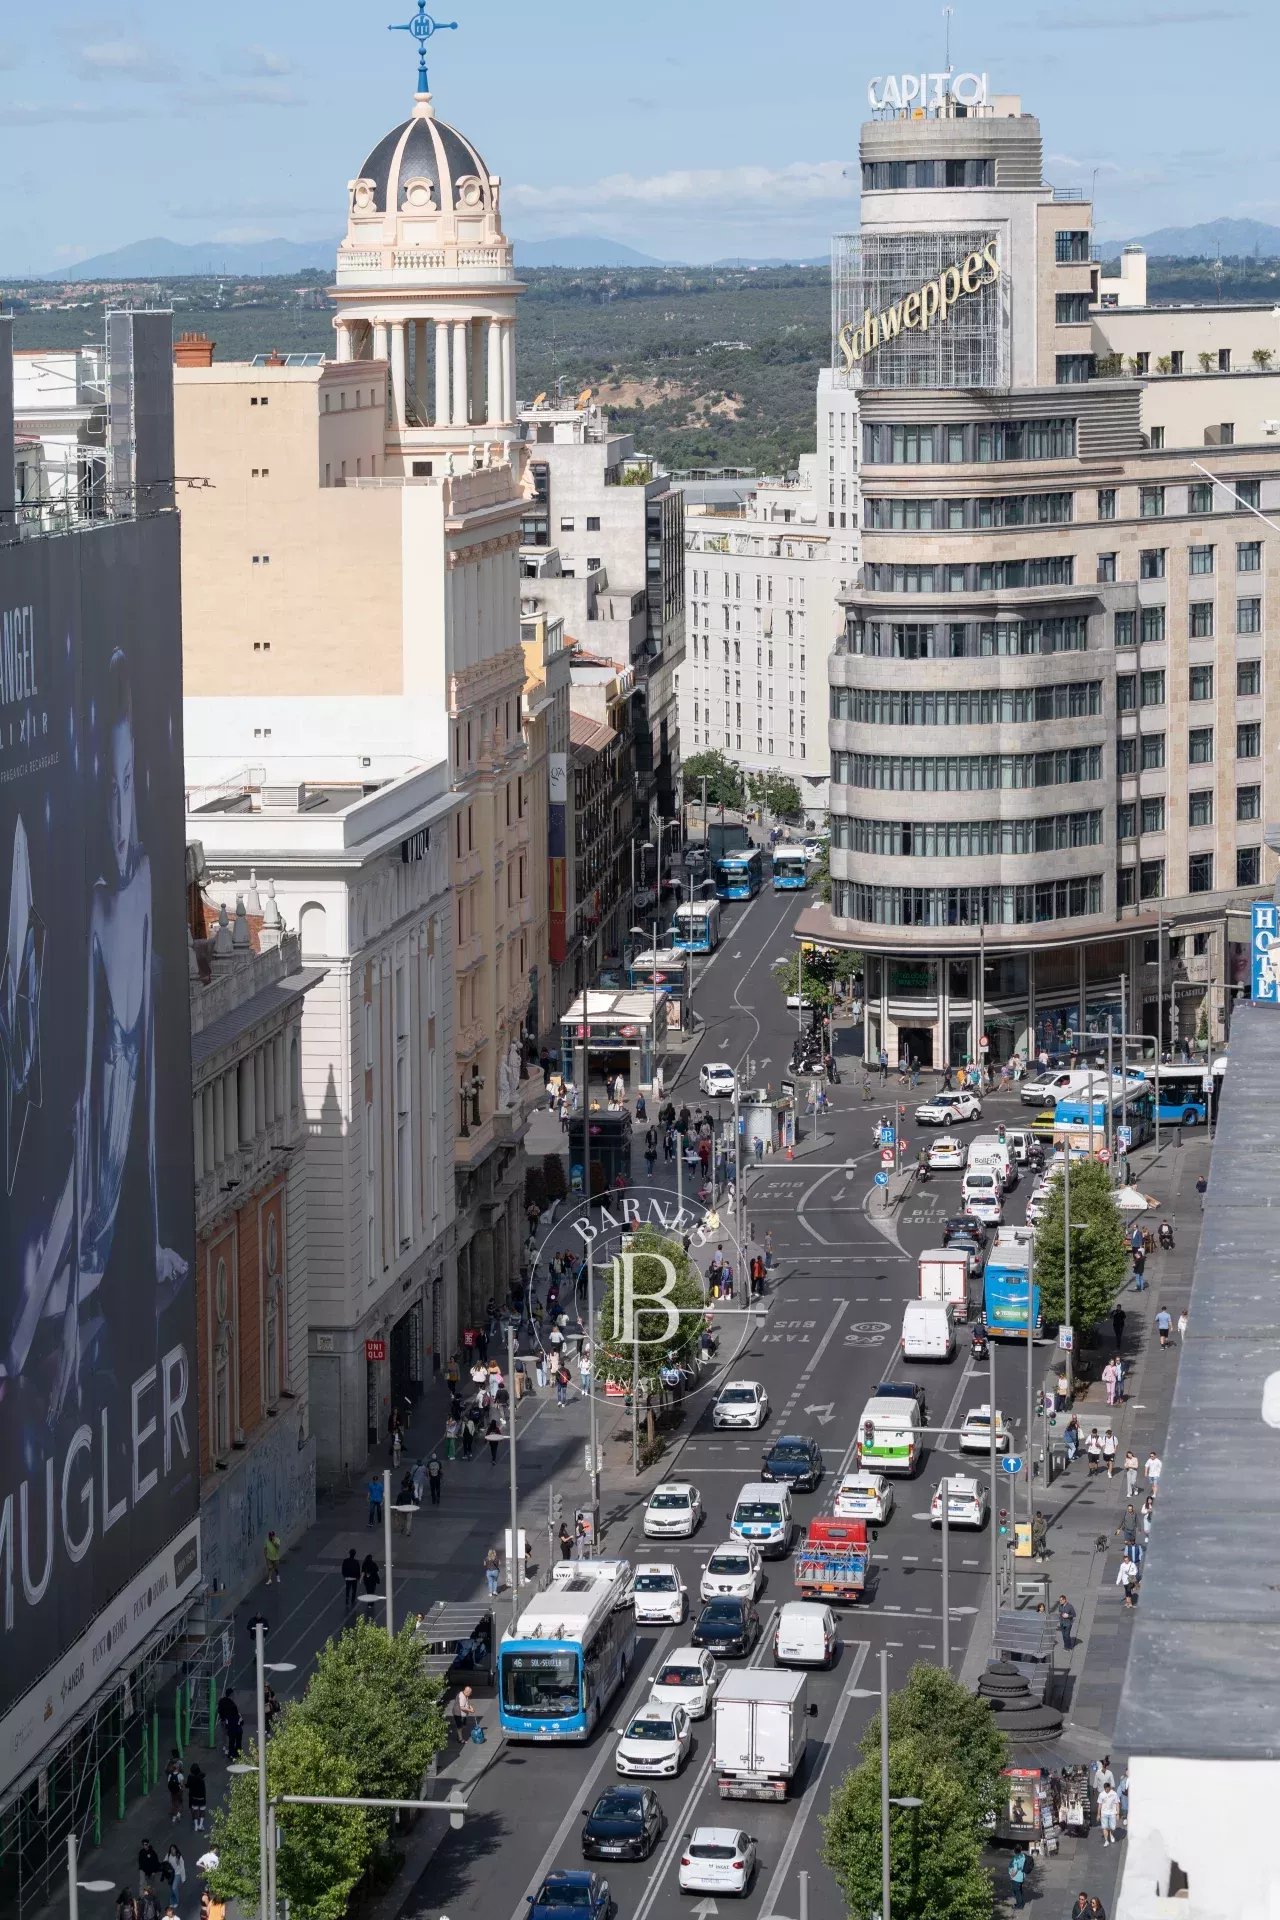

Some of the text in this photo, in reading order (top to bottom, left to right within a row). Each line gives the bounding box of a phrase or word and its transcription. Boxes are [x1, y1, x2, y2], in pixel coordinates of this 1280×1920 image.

[838, 240, 1000, 375] Schweppes
[773, 1320, 817, 1329] BUS
[761, 1334, 810, 1342] TAXI
[368, 1351, 383, 1359] QLO
[513, 1658, 523, 1668] 46
